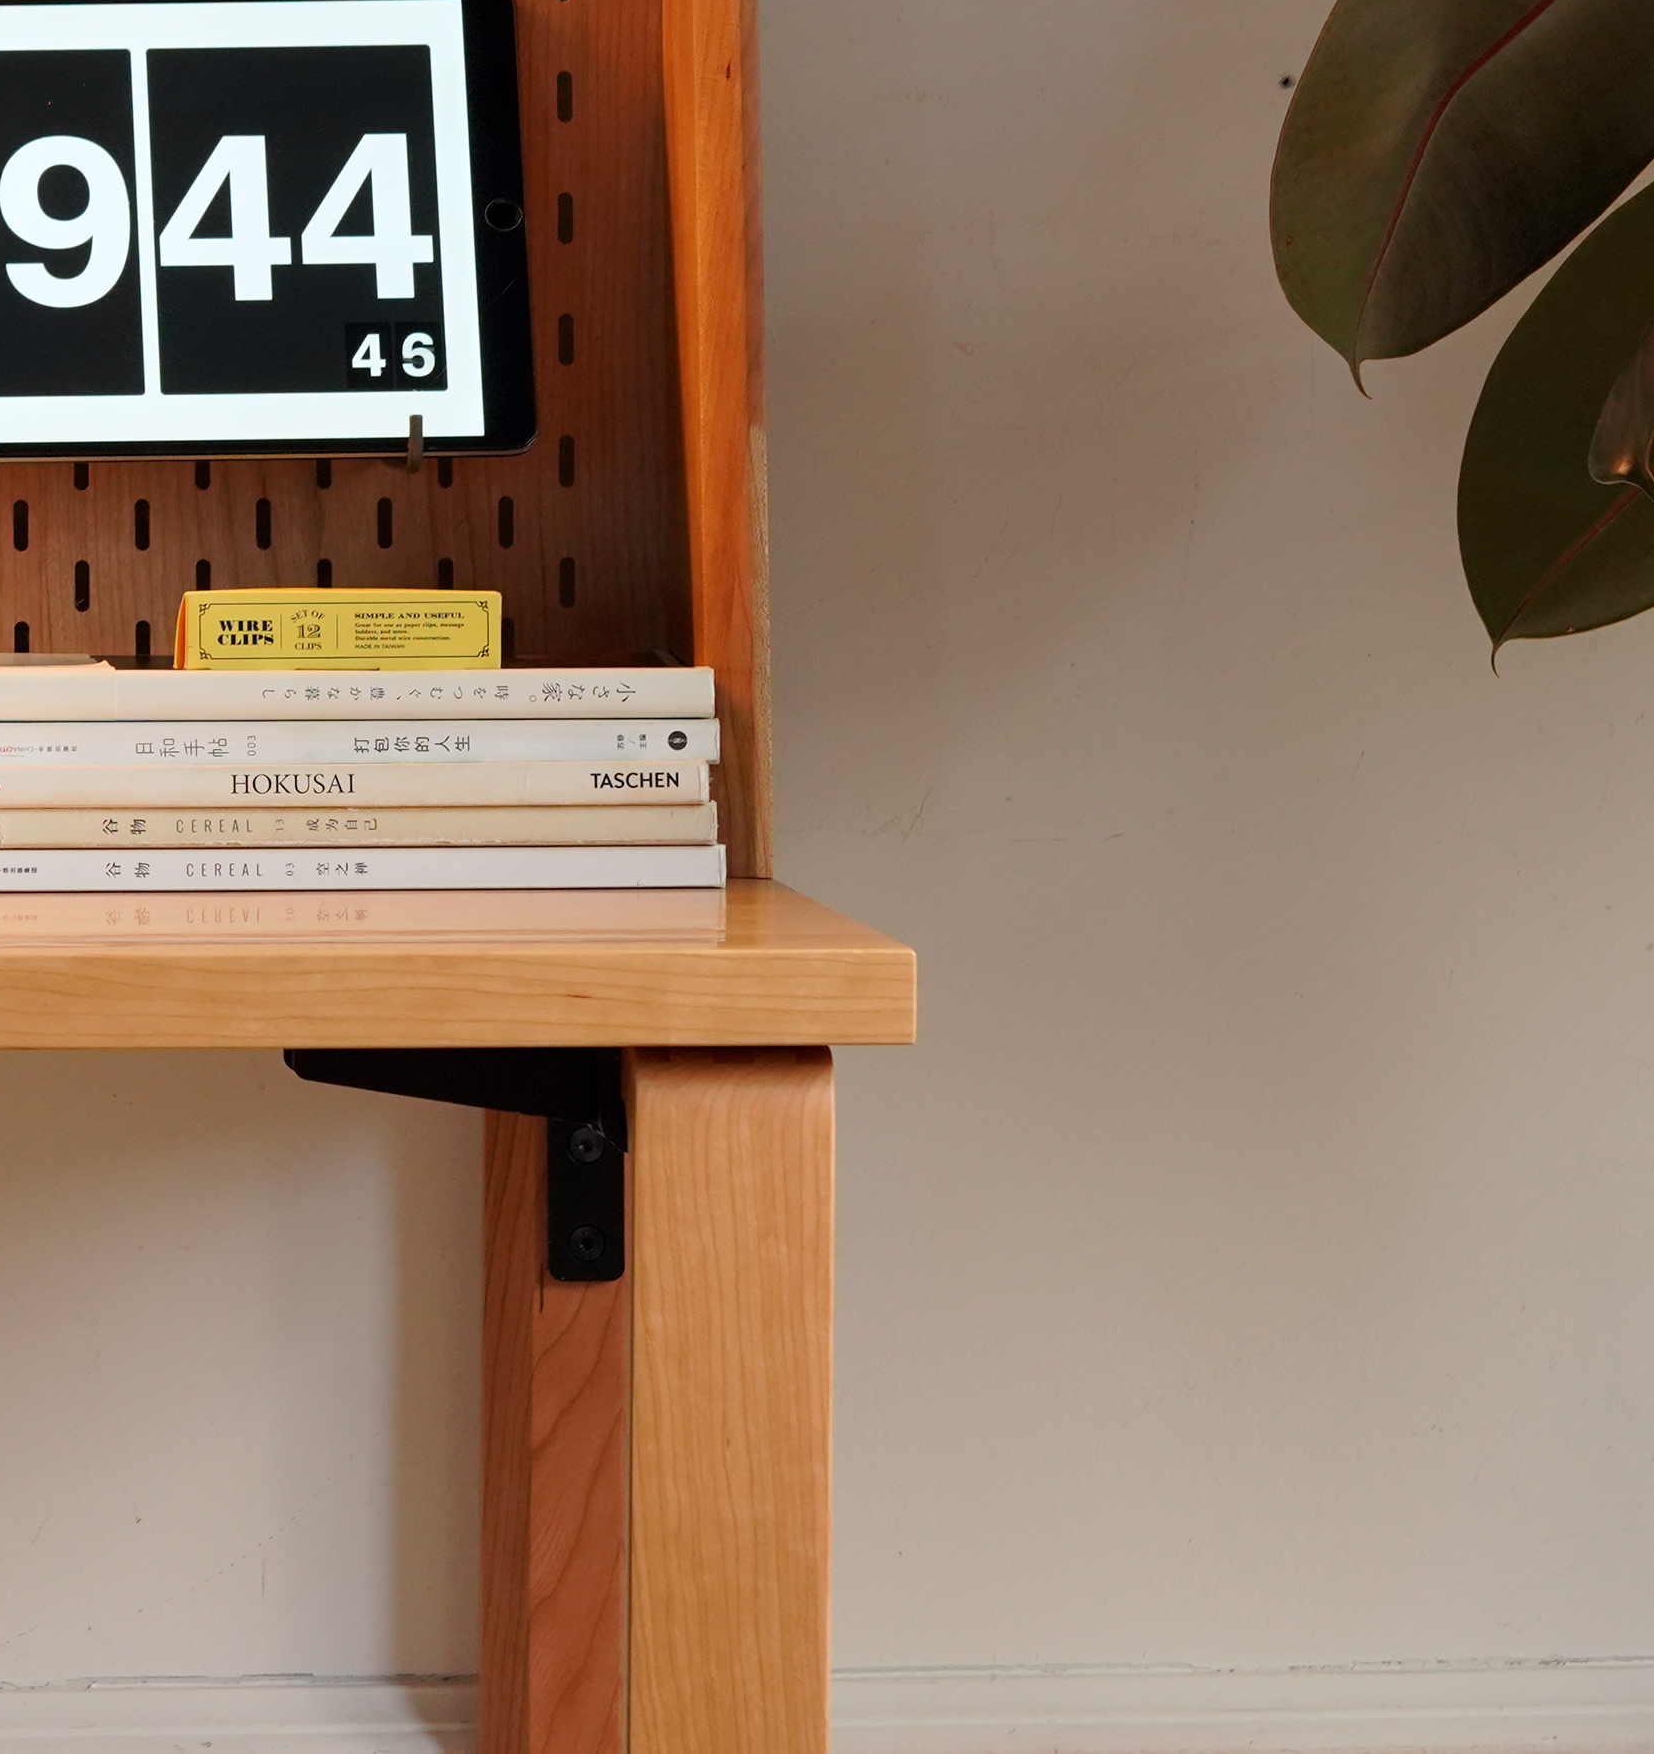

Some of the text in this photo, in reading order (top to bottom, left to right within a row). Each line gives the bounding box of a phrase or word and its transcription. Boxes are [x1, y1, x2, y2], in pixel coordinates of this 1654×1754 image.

[158, 132, 434, 302] 44
[290, 609, 326, 623] SET OF
[219, 620, 273, 632] WIRE
[296, 623, 322, 639] 12
[217, 634, 274, 646] CLIPS
[294, 642, 322, 650] CLIPS
[135, 735, 257, 758] 日和手帖 003
[353, 736, 471, 754] 打包你的人生
[230, 773, 356, 795] HOKUSAI
[590, 772, 679, 789] TASCHEN
[102, 818, 147, 835] 谷物
[176, 819, 285, 833] CEREAL 13
[306, 818, 378, 832] 成为自己
[105, 862, 151, 878] 谷物
[186, 862, 295, 877] CEREAL 03
[316, 862, 369, 876] 空之禅
